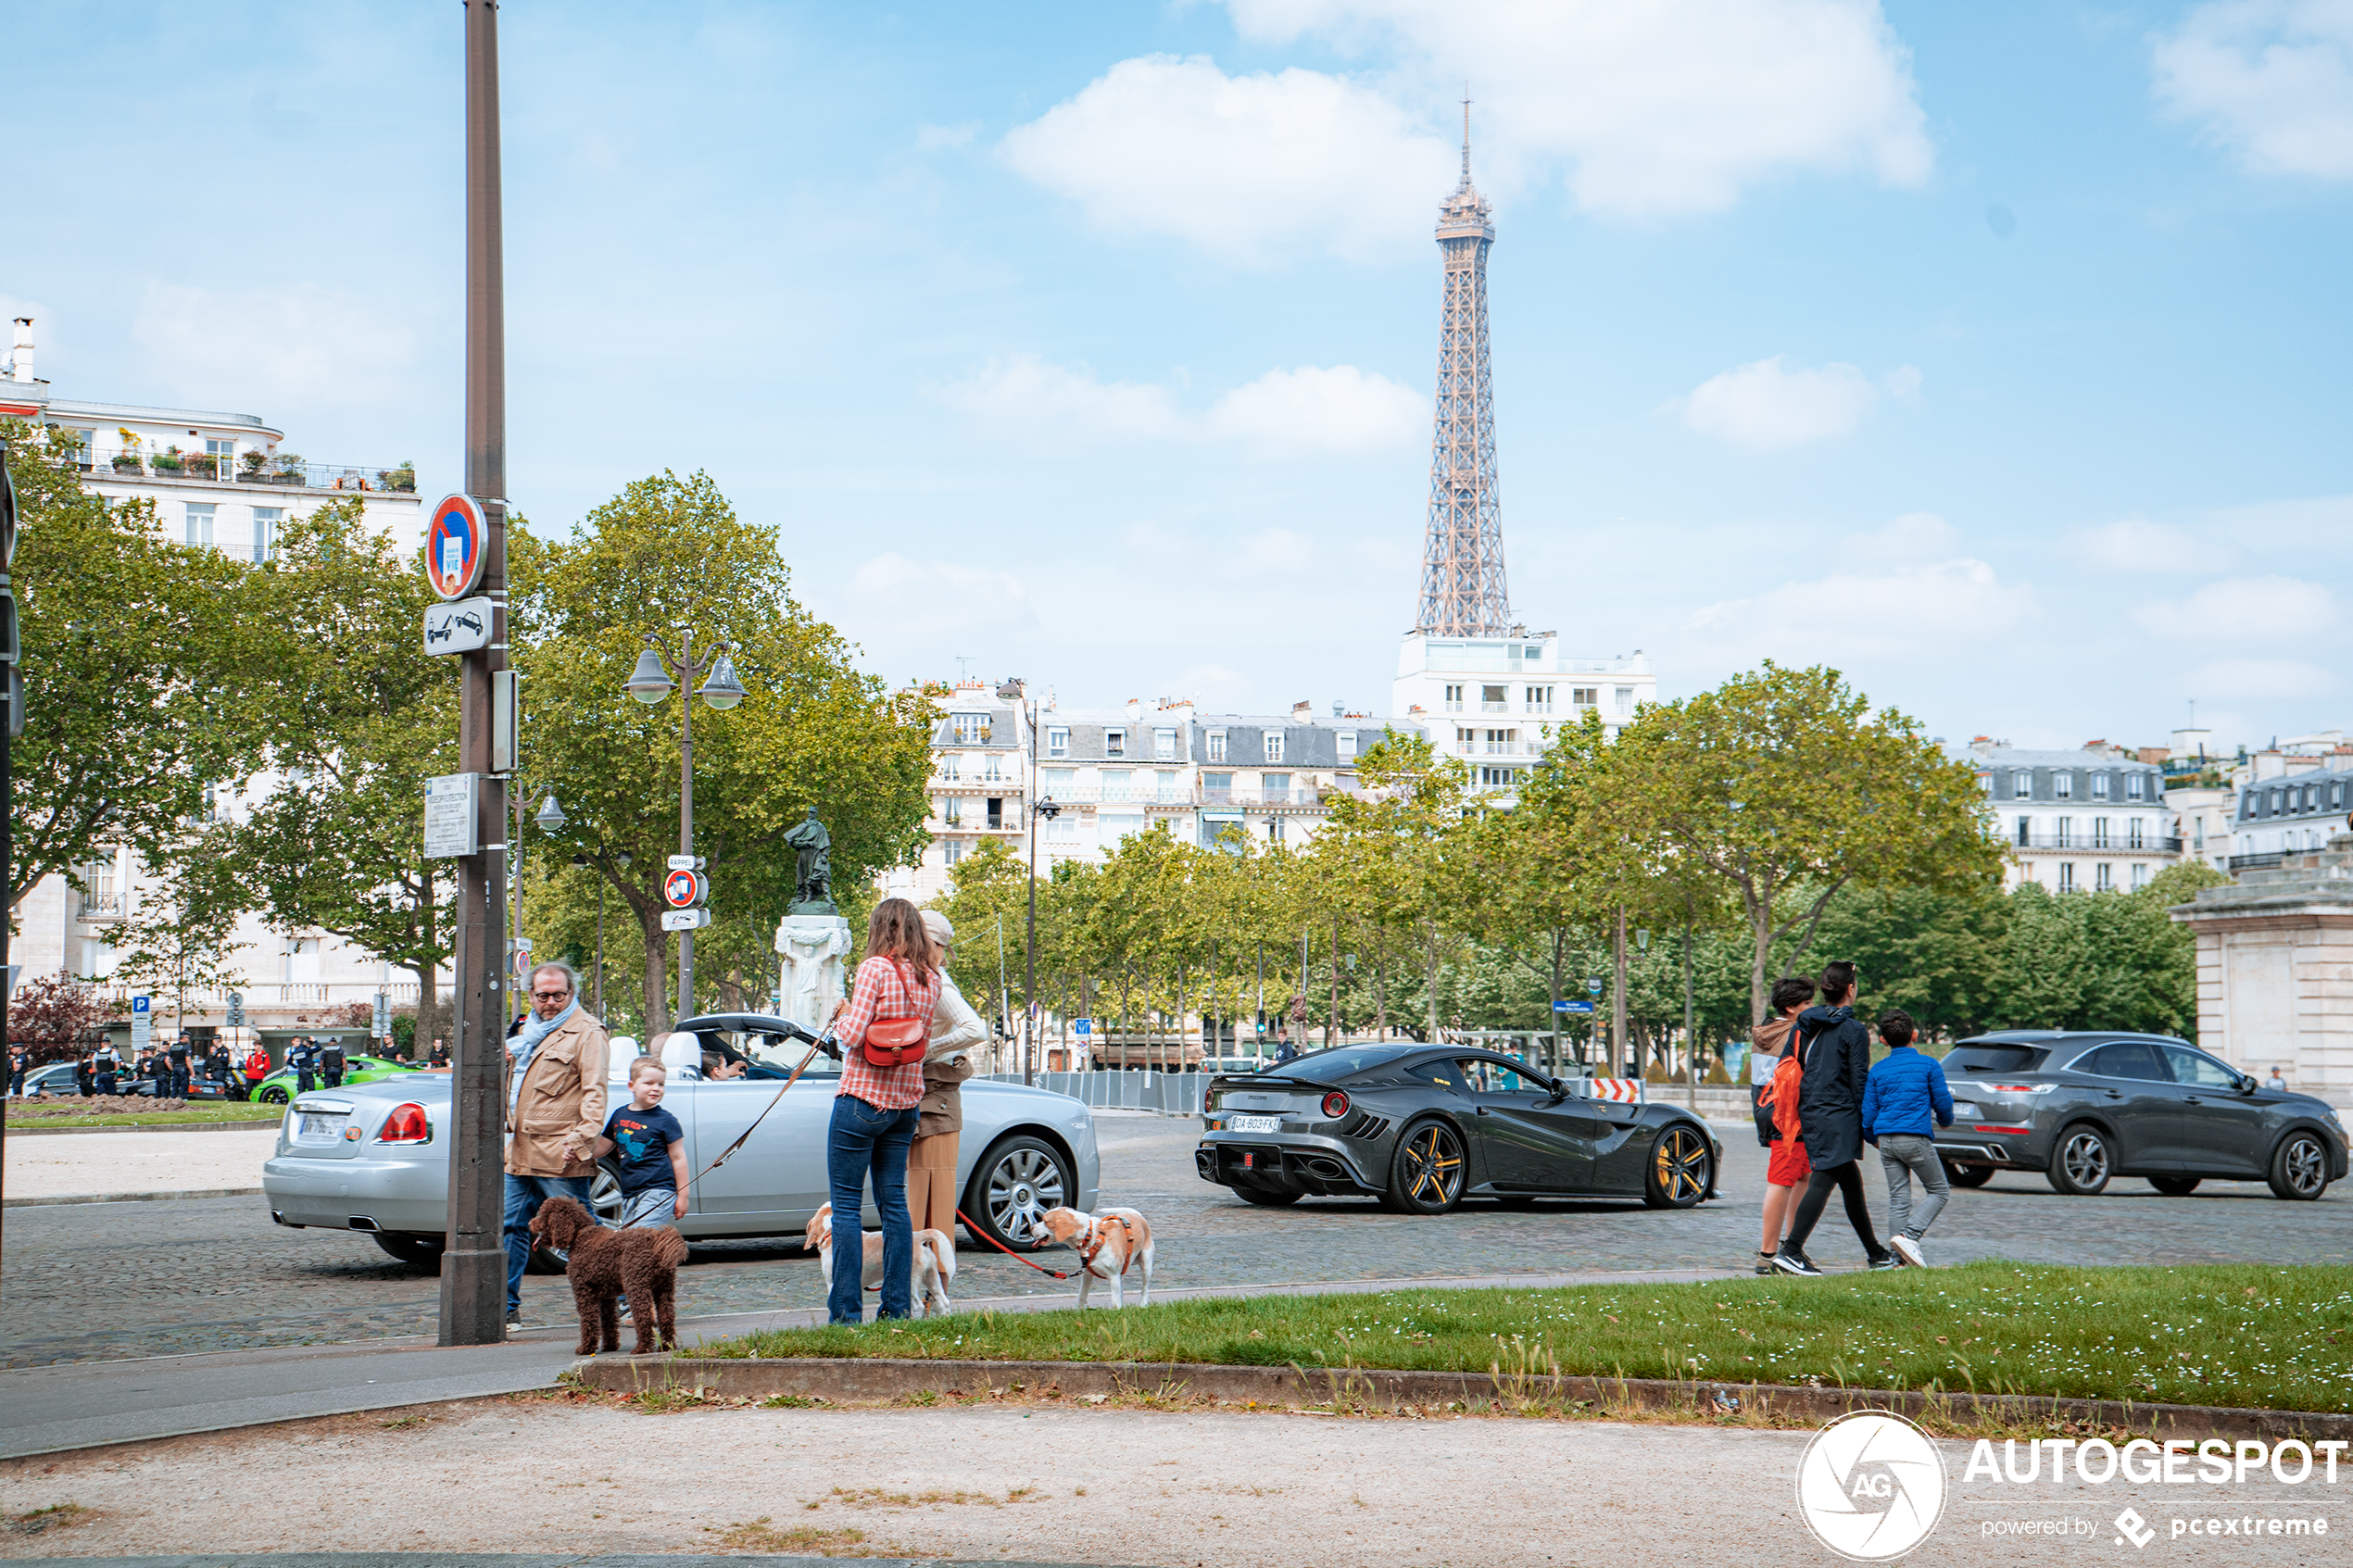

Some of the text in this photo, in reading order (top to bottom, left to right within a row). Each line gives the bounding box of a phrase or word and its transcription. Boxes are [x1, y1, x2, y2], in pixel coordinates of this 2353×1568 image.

[447, 559, 459, 571] VIE
[136, 998, 146, 1010] P
[1235, 1117, 1275, 1130] DA-803-FK
